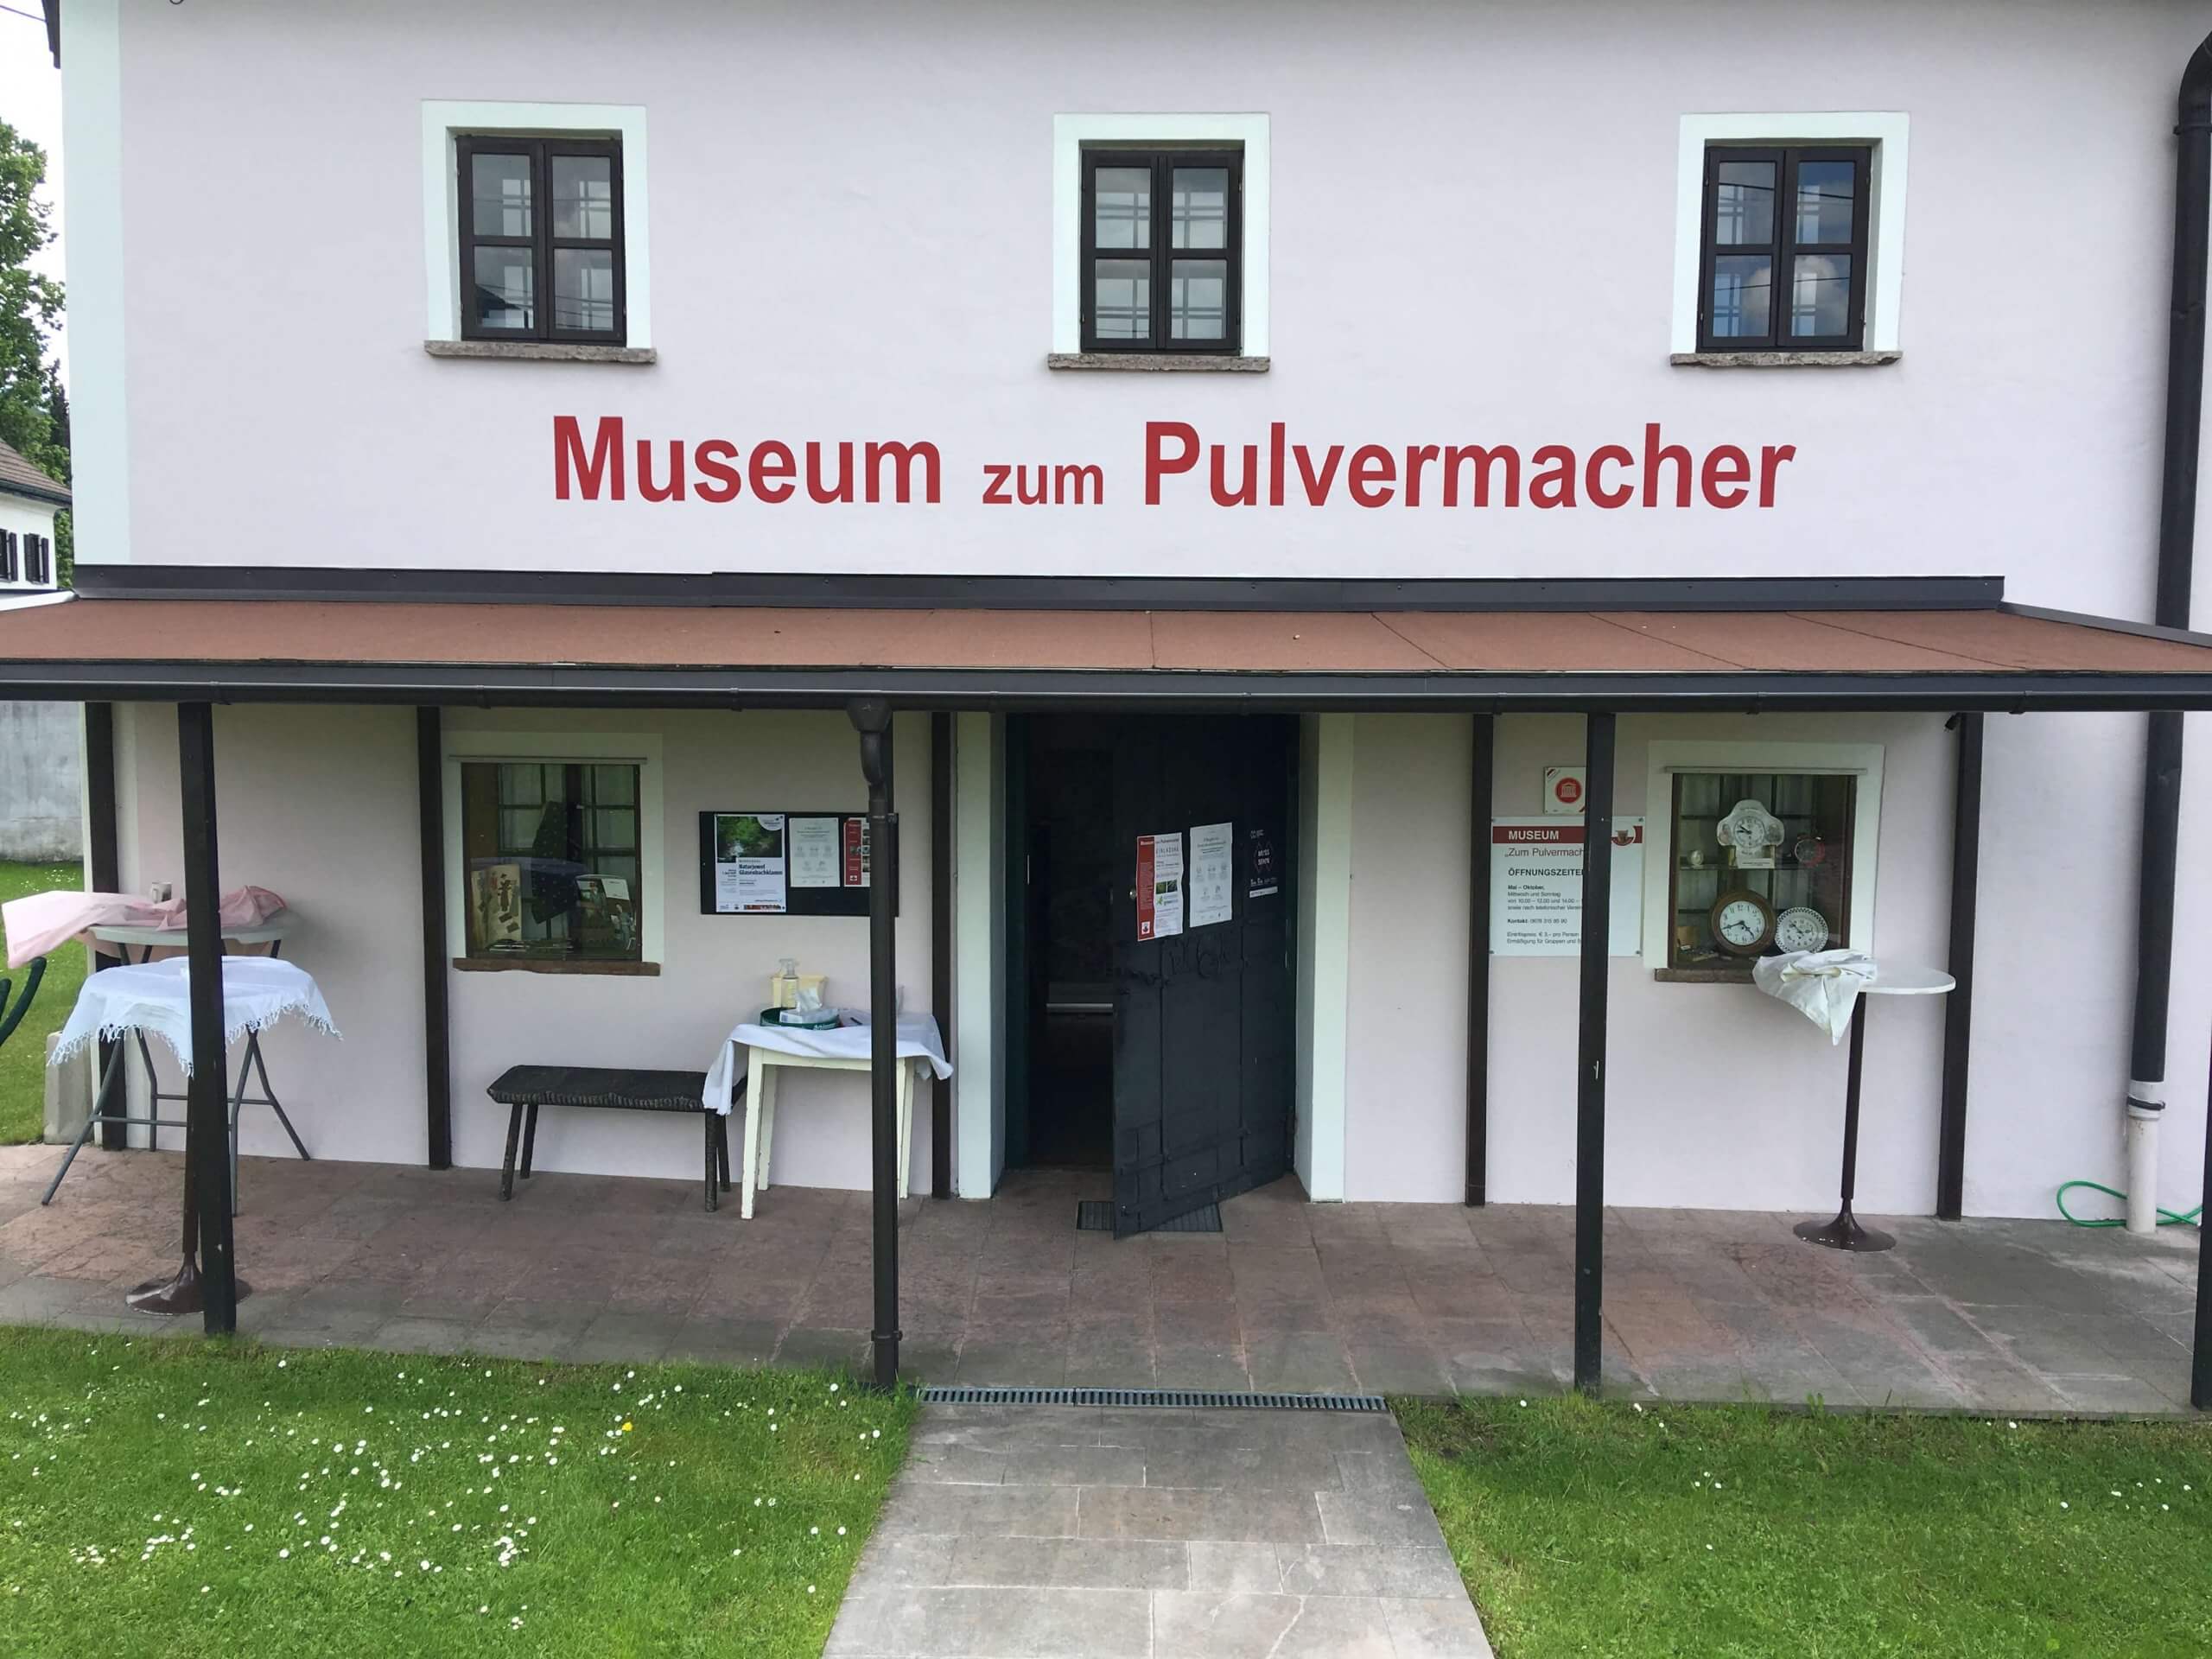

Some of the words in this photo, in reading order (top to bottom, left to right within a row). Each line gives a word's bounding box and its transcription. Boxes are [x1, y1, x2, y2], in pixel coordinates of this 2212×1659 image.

[554, 416, 940, 503] Museum
[982, 465, 1103, 505] zum
[1145, 422, 1796, 509] Pulvermacher
[1508, 830, 1560, 840] MUSEUM
